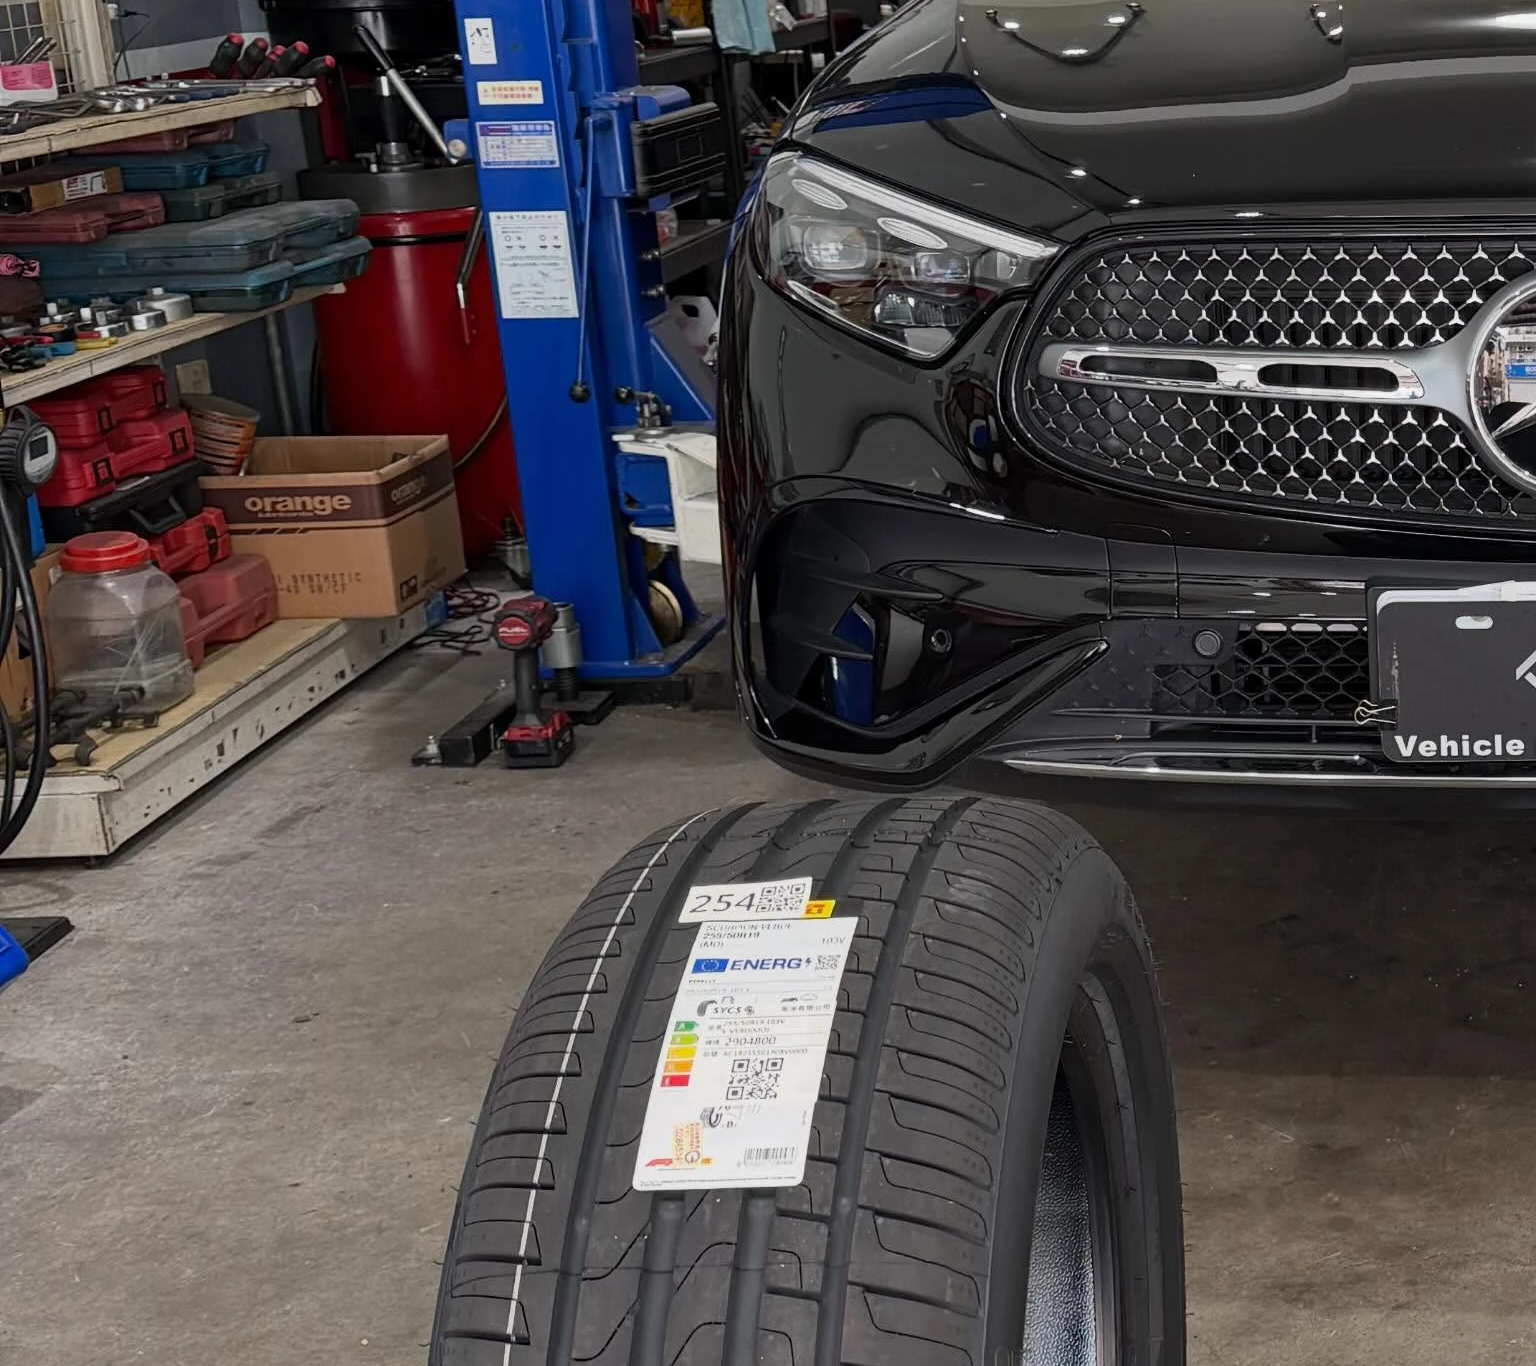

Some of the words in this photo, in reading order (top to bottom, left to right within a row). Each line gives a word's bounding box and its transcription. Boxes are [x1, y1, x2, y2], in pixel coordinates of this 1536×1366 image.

[244, 494, 353, 516] orange
[1394, 734, 1526, 758] Vehicle
[689, 892, 757, 914] 254
[730, 957, 803, 971] ENERG
